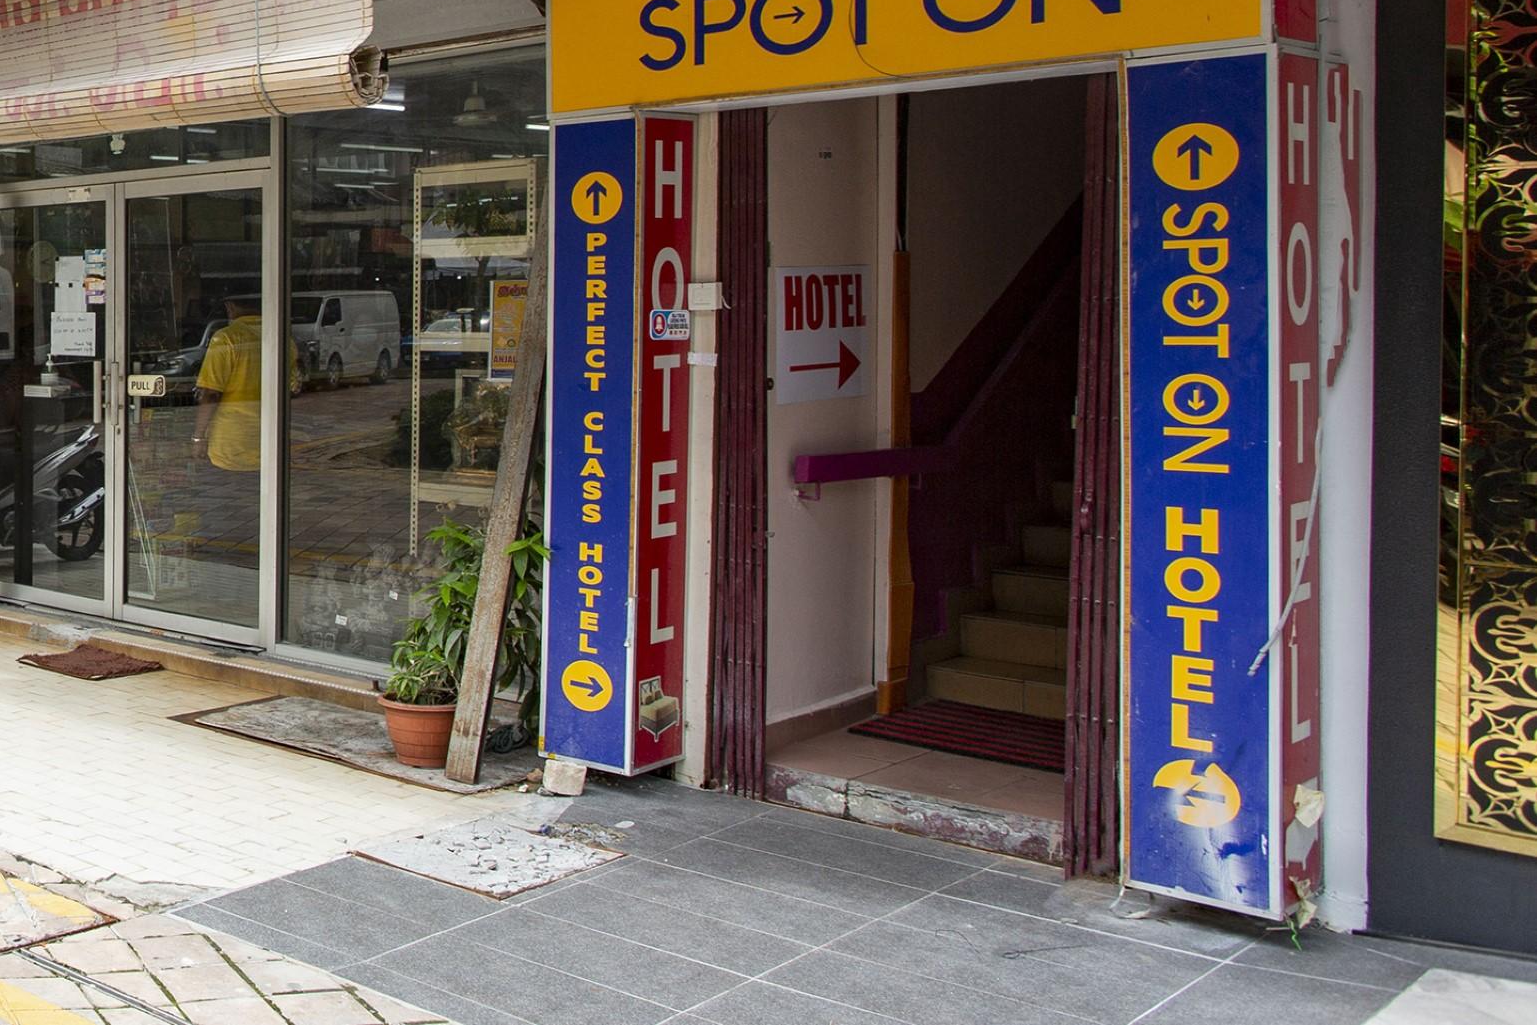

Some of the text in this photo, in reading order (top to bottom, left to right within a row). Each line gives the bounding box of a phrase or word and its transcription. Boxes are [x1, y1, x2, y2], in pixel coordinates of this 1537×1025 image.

[583, 232, 608, 392] PERFECT
[783, 273, 867, 332] HOTEL
[130, 380, 151, 391] PULL
[649, 139, 684, 645] HOTEL
[1285, 81, 1313, 744] HOTEL
[579, 411, 606, 524] CLASS
[1161, 202, 1230, 753] SPOT ON HOTEL
[577, 542, 603, 655] HOTEL
